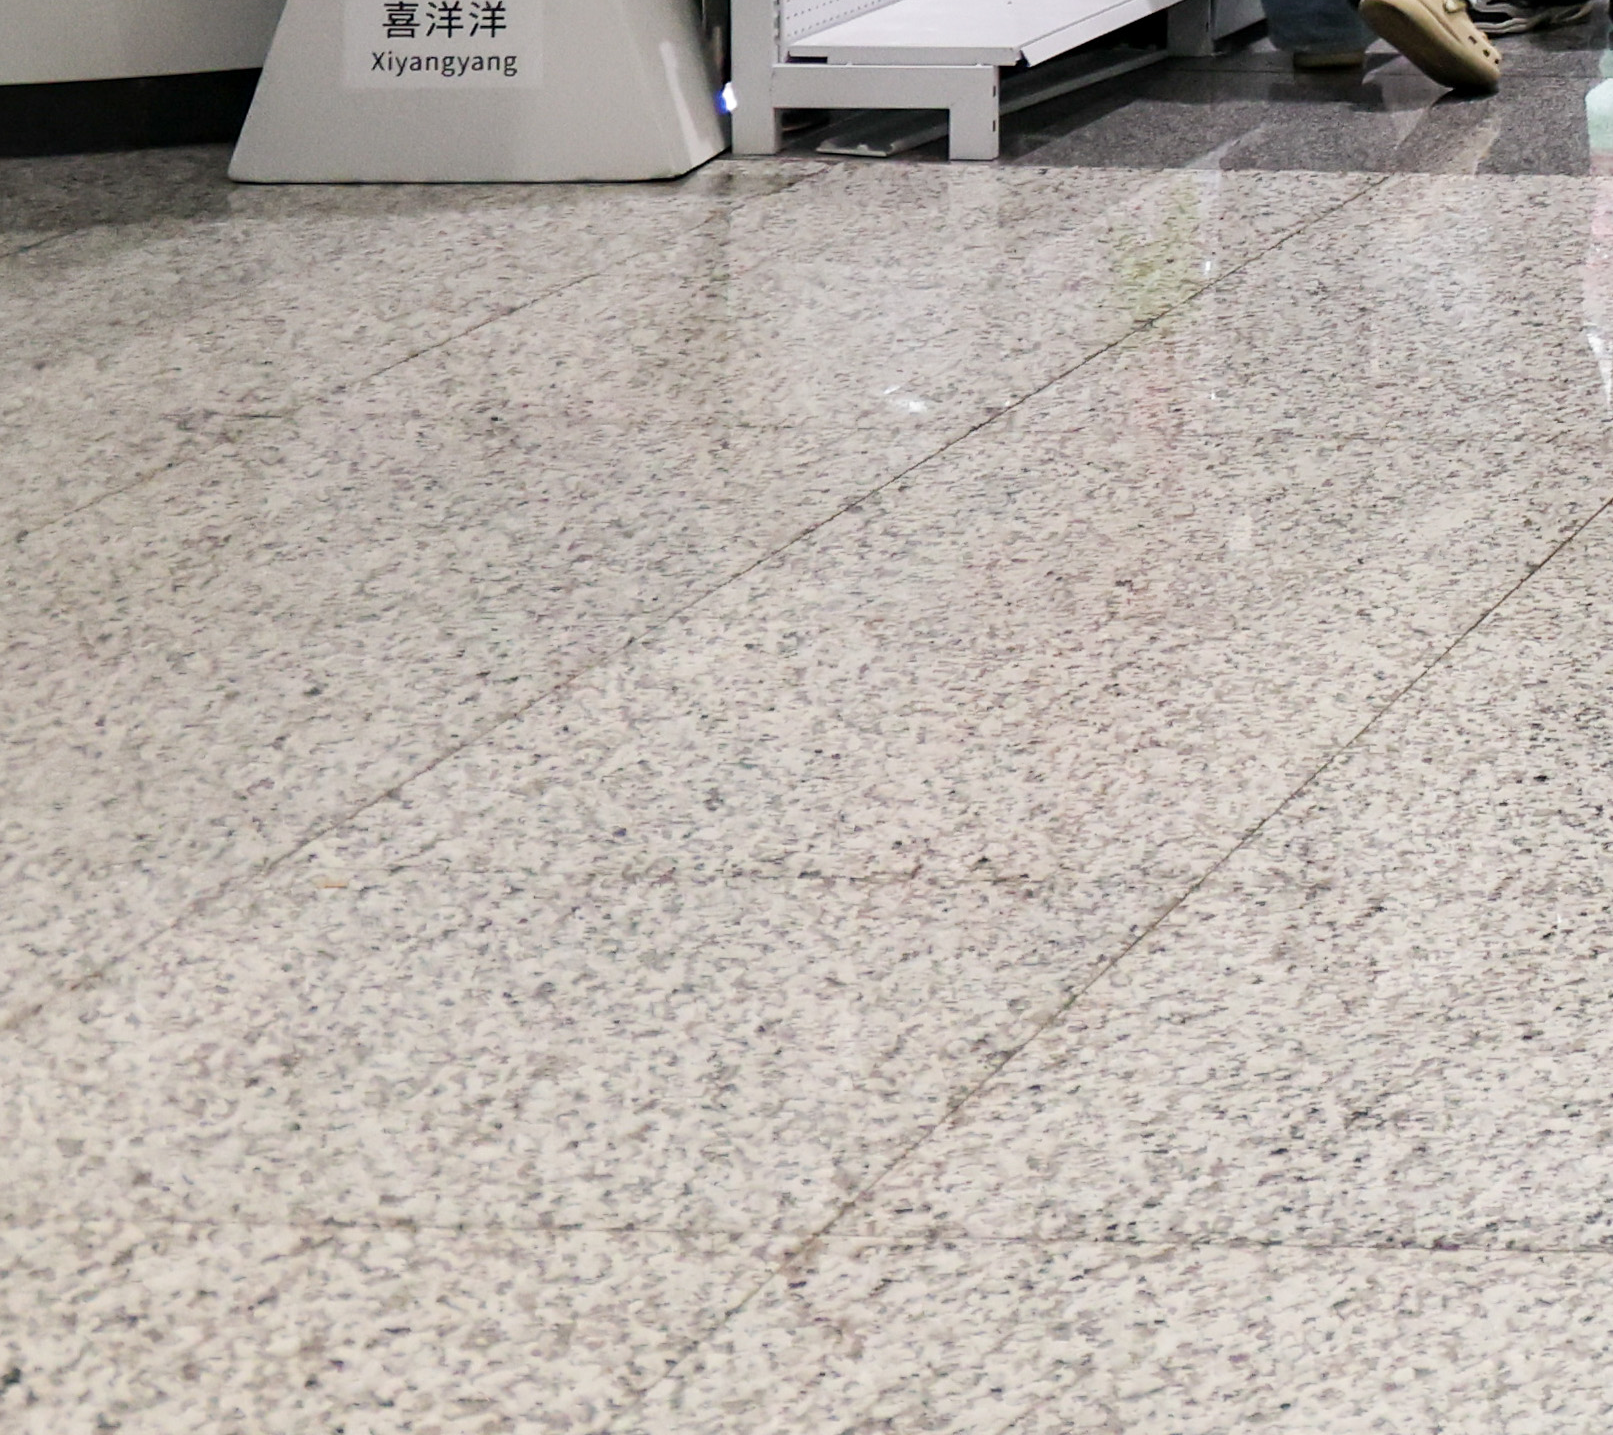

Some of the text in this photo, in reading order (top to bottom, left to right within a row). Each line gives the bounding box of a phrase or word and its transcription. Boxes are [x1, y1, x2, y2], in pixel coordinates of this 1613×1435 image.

[382, 0, 507, 39] 喜洋洋
[371, 50, 518, 77] Xiyangyang
